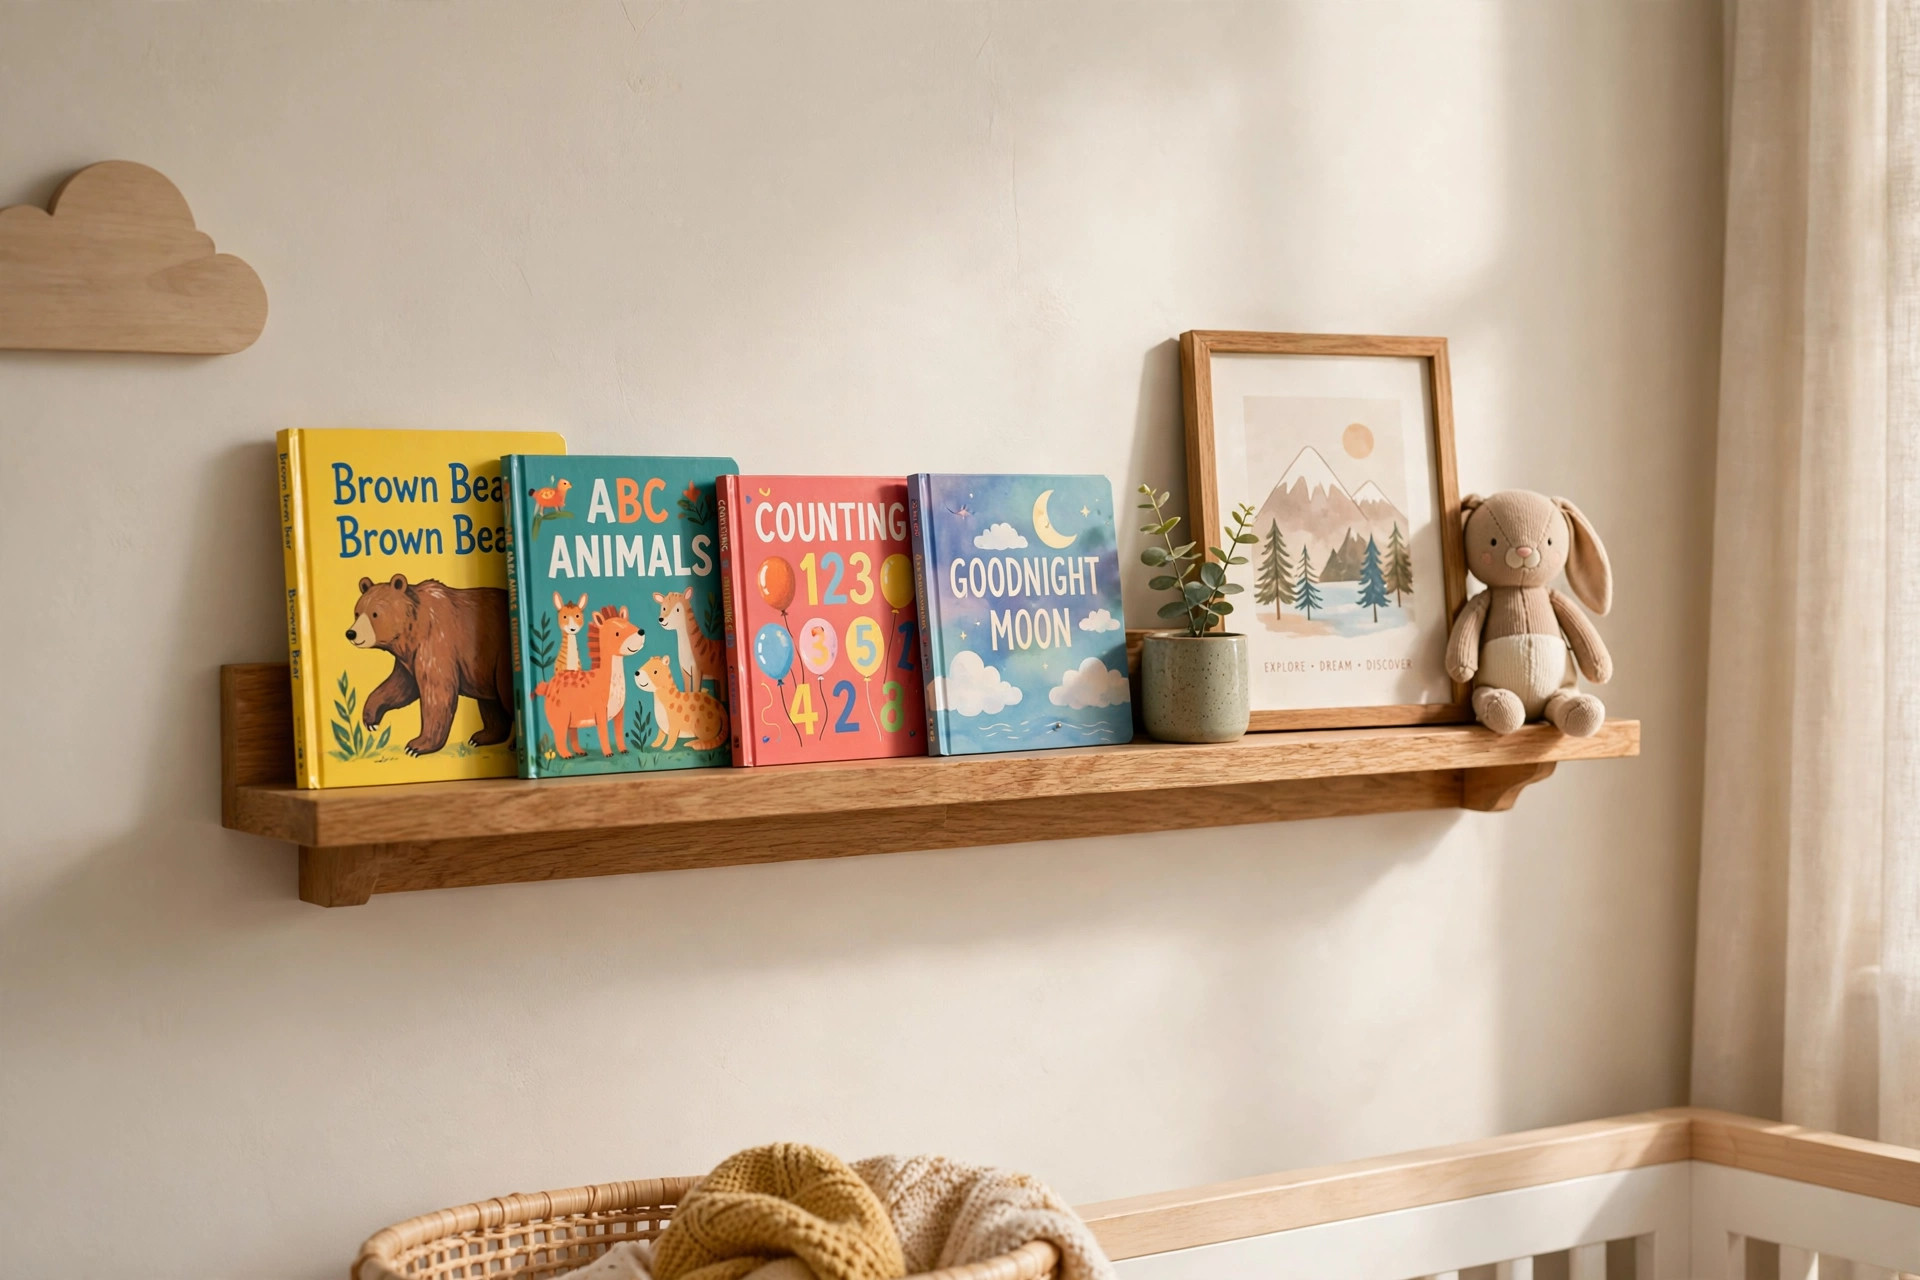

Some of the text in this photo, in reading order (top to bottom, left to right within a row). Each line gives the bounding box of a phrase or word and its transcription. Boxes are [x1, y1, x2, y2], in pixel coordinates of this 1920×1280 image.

[332, 462, 503, 505] Brown Bea
[587, 477, 669, 524] ABC
[336, 514, 507, 559] Brown Bea
[754, 501, 907, 543] COUNTING
[548, 534, 713, 579] ANIMALS
[949, 555, 1100, 599] GOODNIGHT
[856, 624, 877, 667] 5
[990, 607, 1072, 652] MOON
[1264, 658, 1414, 673] EXPLORE DREAM DISCOVER
[790, 682, 819, 736] 4
[832, 680, 860, 734] 2
